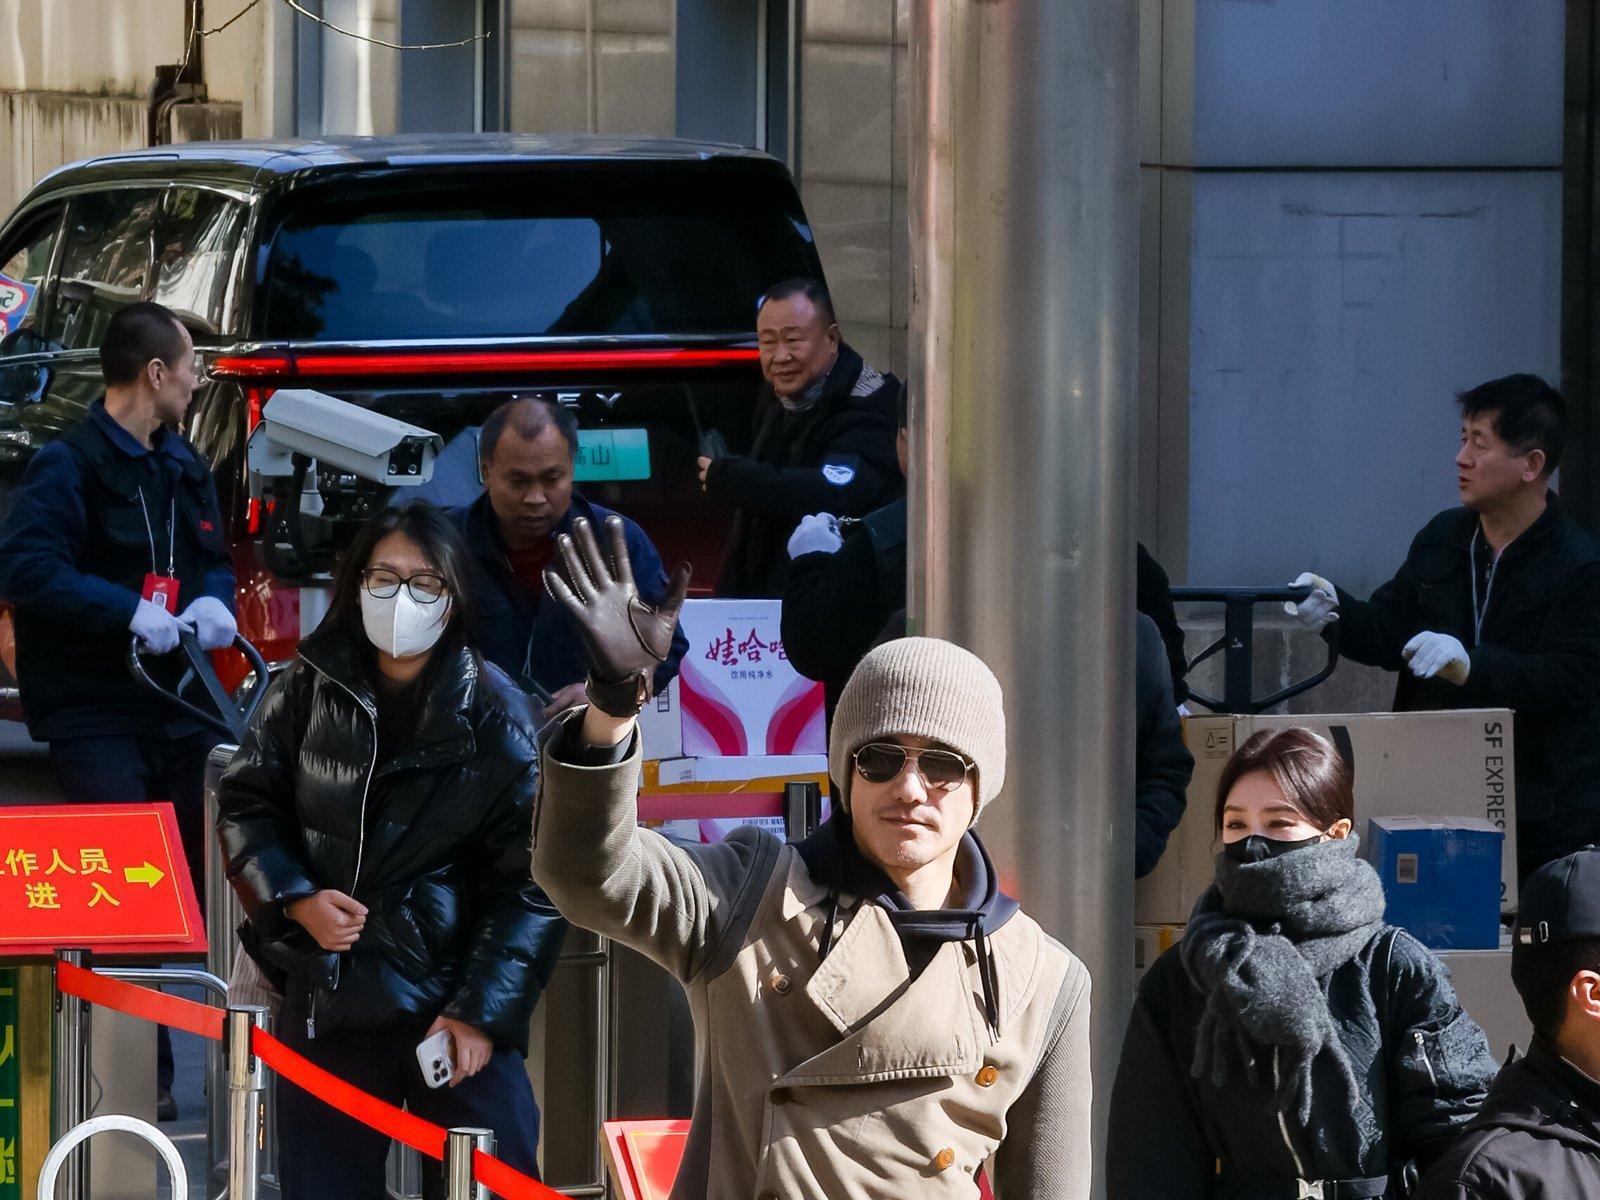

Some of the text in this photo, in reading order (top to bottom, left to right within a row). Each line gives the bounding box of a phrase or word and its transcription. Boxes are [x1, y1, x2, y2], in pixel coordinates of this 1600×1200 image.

[730, 670, 774, 680] 饮用纯净水
[1484, 722, 1506, 840] SF EXPRE
[0, 848, 112, 877] 作人员
[25, 881, 120, 909] 进入
